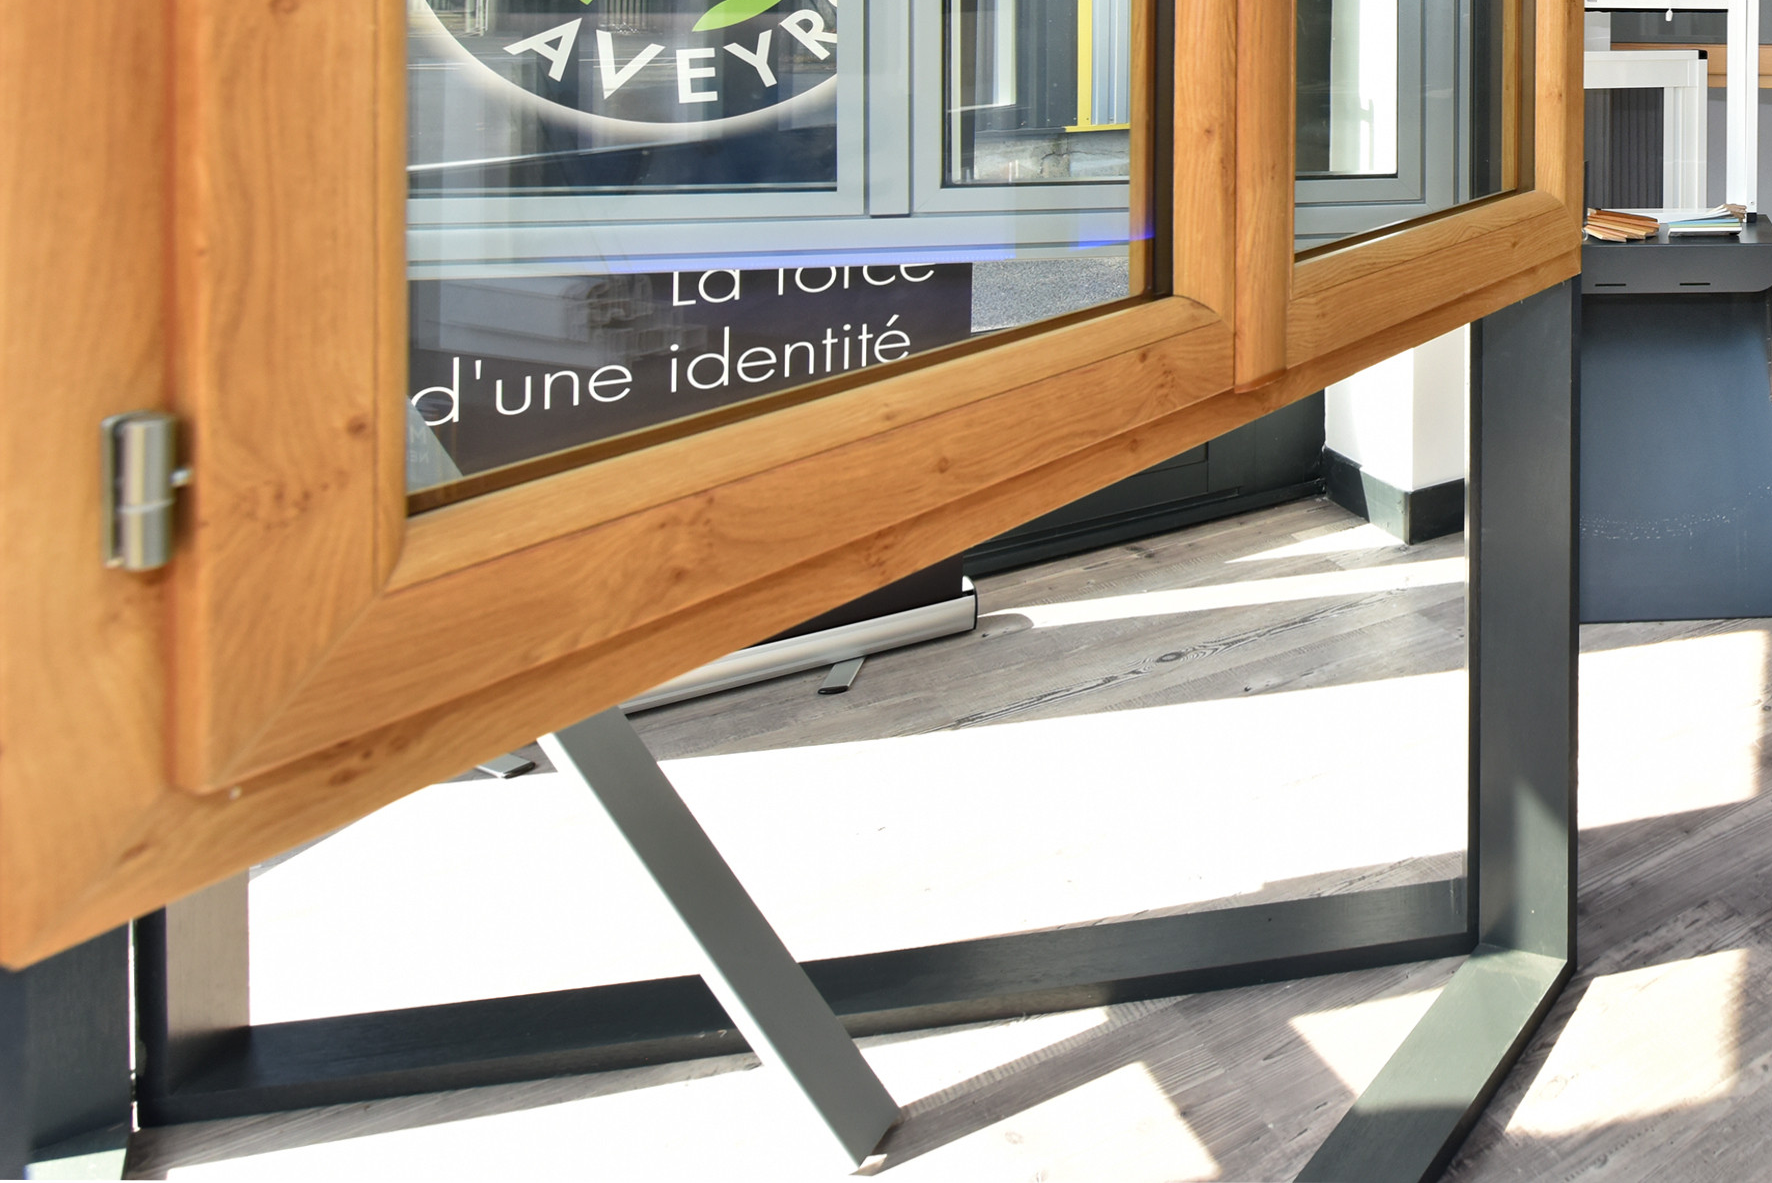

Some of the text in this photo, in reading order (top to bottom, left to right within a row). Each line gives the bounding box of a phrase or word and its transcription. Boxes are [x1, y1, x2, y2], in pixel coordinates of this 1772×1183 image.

[672, 269, 741, 306] La
[411, 314, 911, 427] d'une identité
